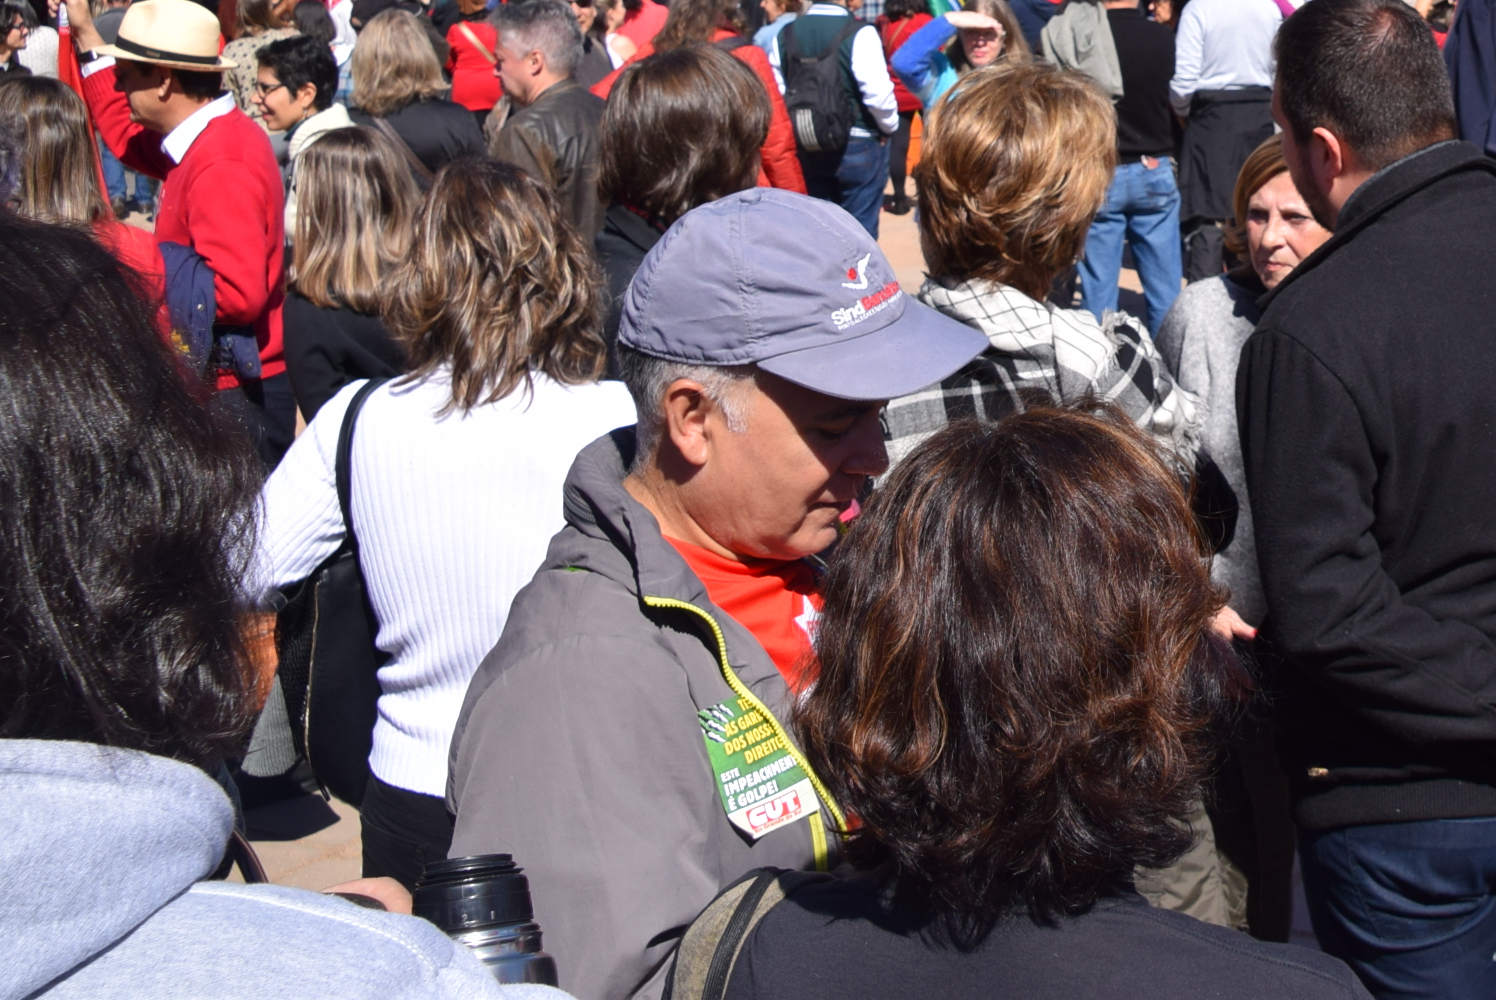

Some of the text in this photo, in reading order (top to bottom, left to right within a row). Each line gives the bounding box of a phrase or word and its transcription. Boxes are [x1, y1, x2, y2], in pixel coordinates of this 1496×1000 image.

[725, 721, 739, 738] AS
[723, 735, 747, 757] DOS
[720, 767, 741, 783] ESTE
[727, 779, 779, 812] É GOLPE!
[748, 791, 799, 828] CUT
